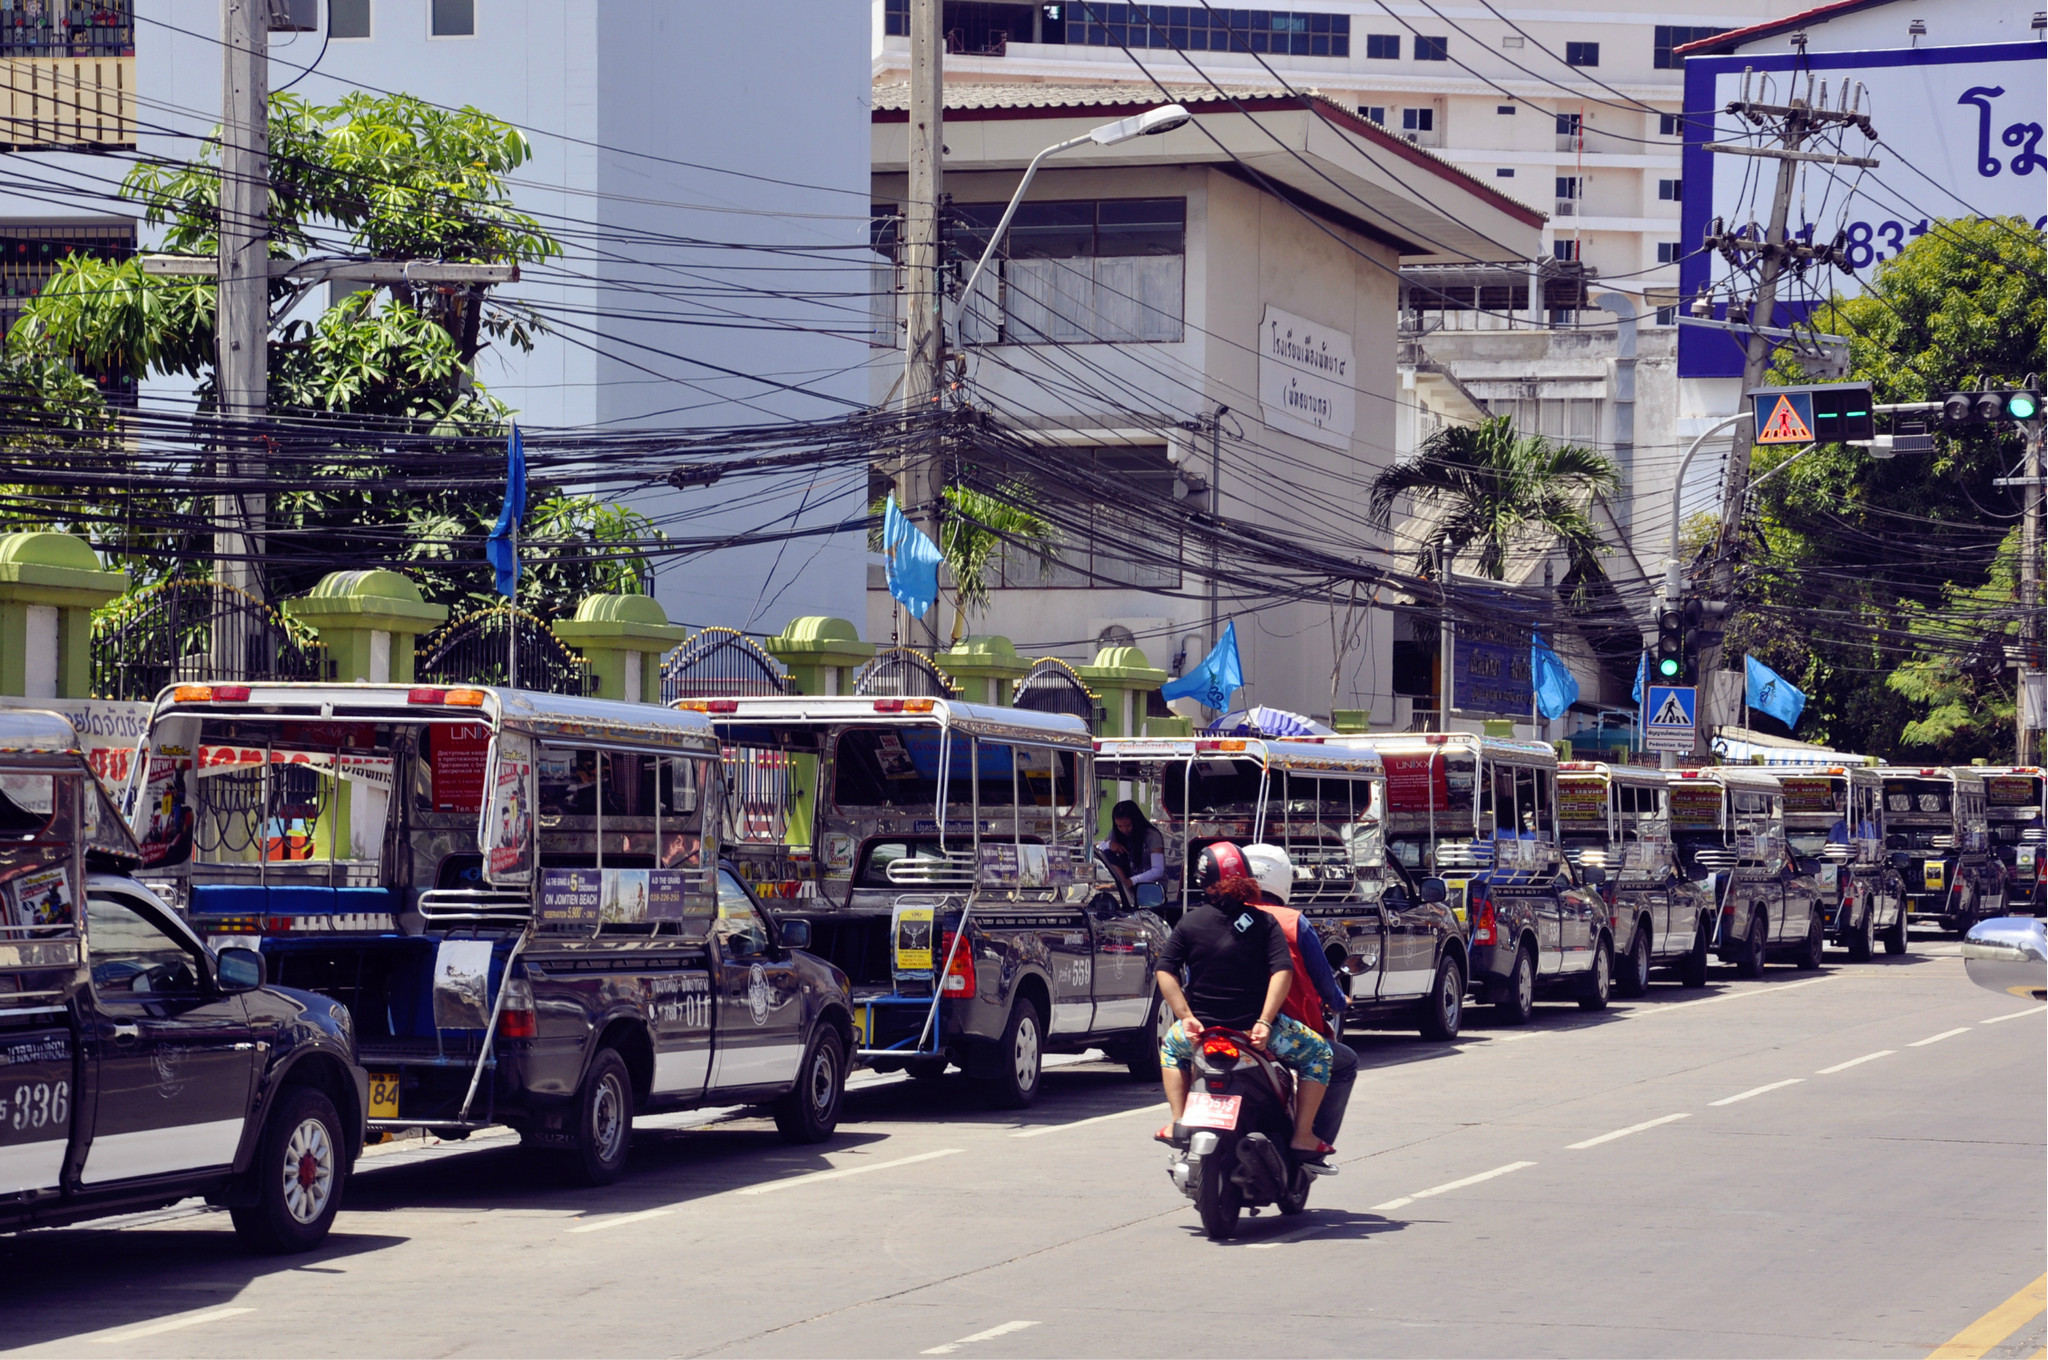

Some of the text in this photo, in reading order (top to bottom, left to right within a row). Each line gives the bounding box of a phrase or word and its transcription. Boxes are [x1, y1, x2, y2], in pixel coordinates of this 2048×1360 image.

[151, 760, 173, 773] NEW!
[570, 873, 578, 892] 5
[544, 893, 598, 906] ON JOMTIEN BEACH
[1072, 958, 1091, 986] 559
[373, 1082, 399, 1106] 84
